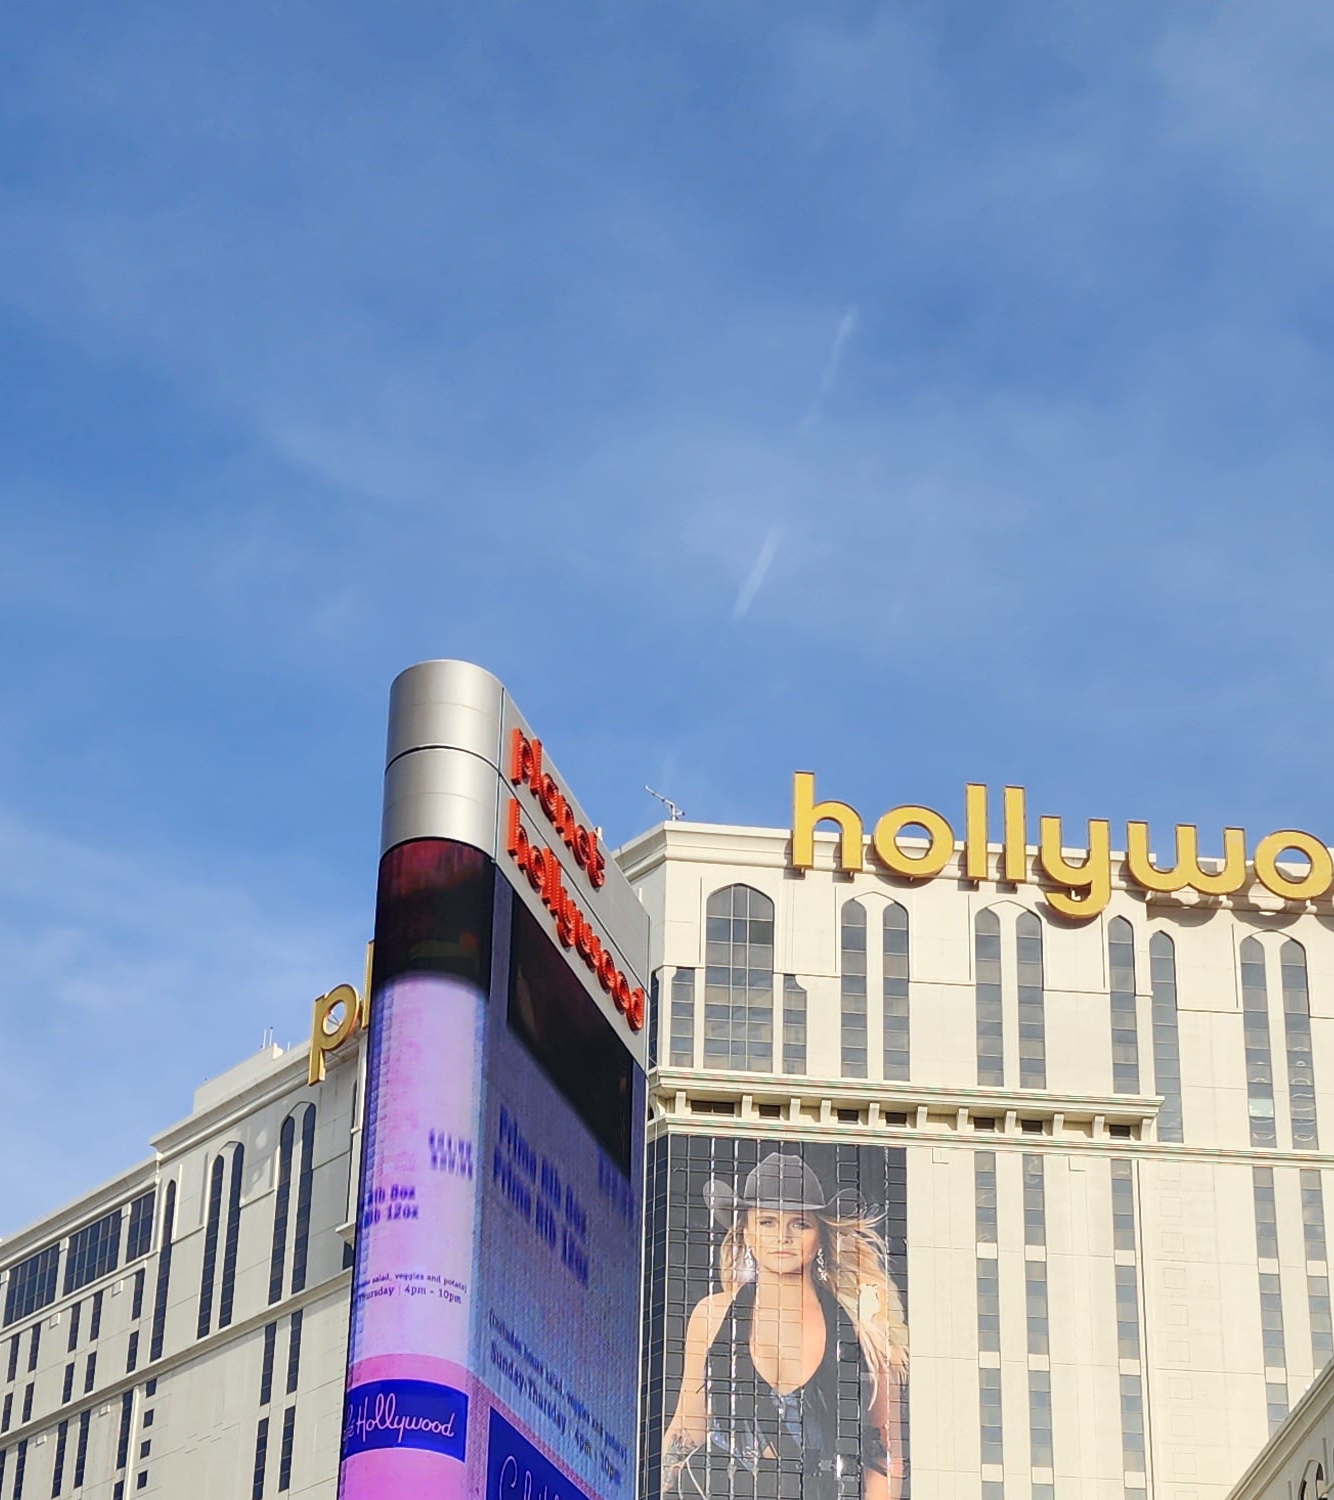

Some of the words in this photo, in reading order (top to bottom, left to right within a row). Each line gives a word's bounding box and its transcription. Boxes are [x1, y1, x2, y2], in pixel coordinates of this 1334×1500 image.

[507, 797, 644, 1031] hollywood
[404, 1284, 427, 1296] 4pm
[439, 1288, 461, 1305] 10pm
[427, 1274, 441, 1283] and
[356, 1393, 455, 1443] Hollywood
